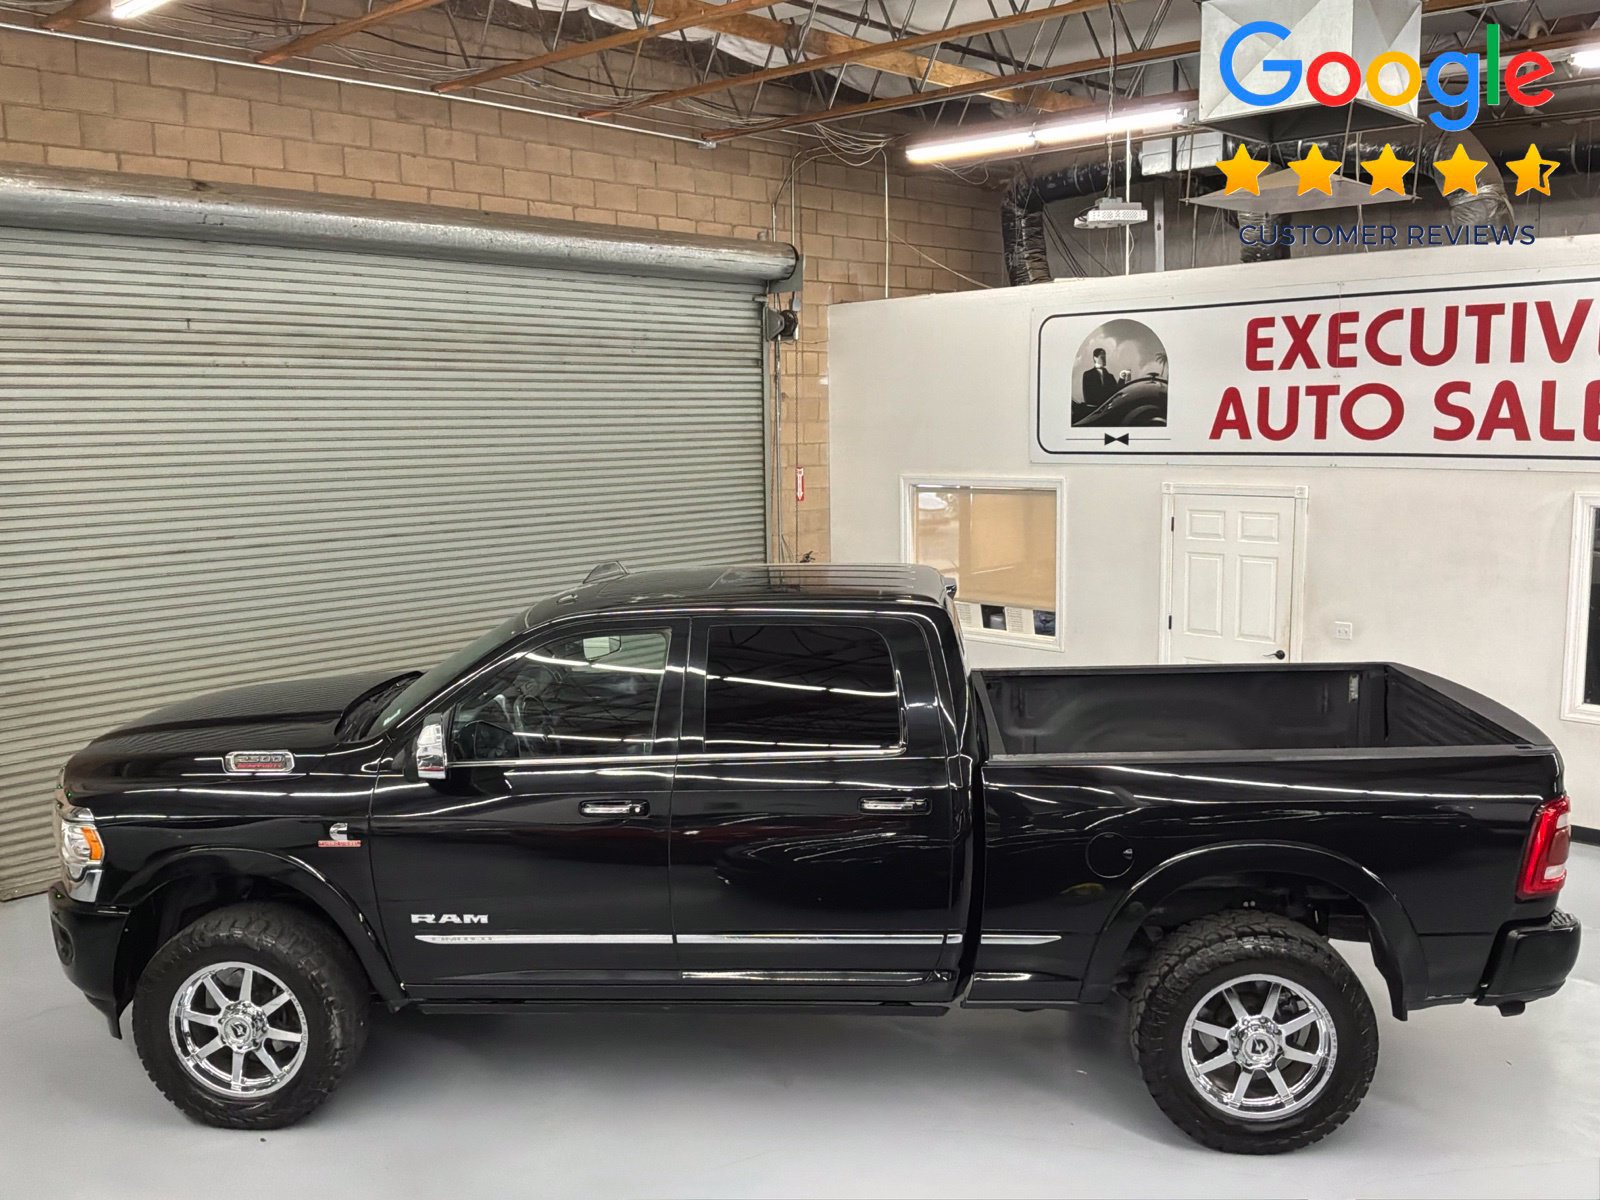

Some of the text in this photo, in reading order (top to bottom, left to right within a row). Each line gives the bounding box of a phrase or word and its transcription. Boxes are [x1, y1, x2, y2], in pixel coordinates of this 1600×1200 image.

[1246, 299, 1600, 371] EXECUTIV
[1209, 382, 1405, 441] AUTO
[410, 914, 489, 924] RAM
